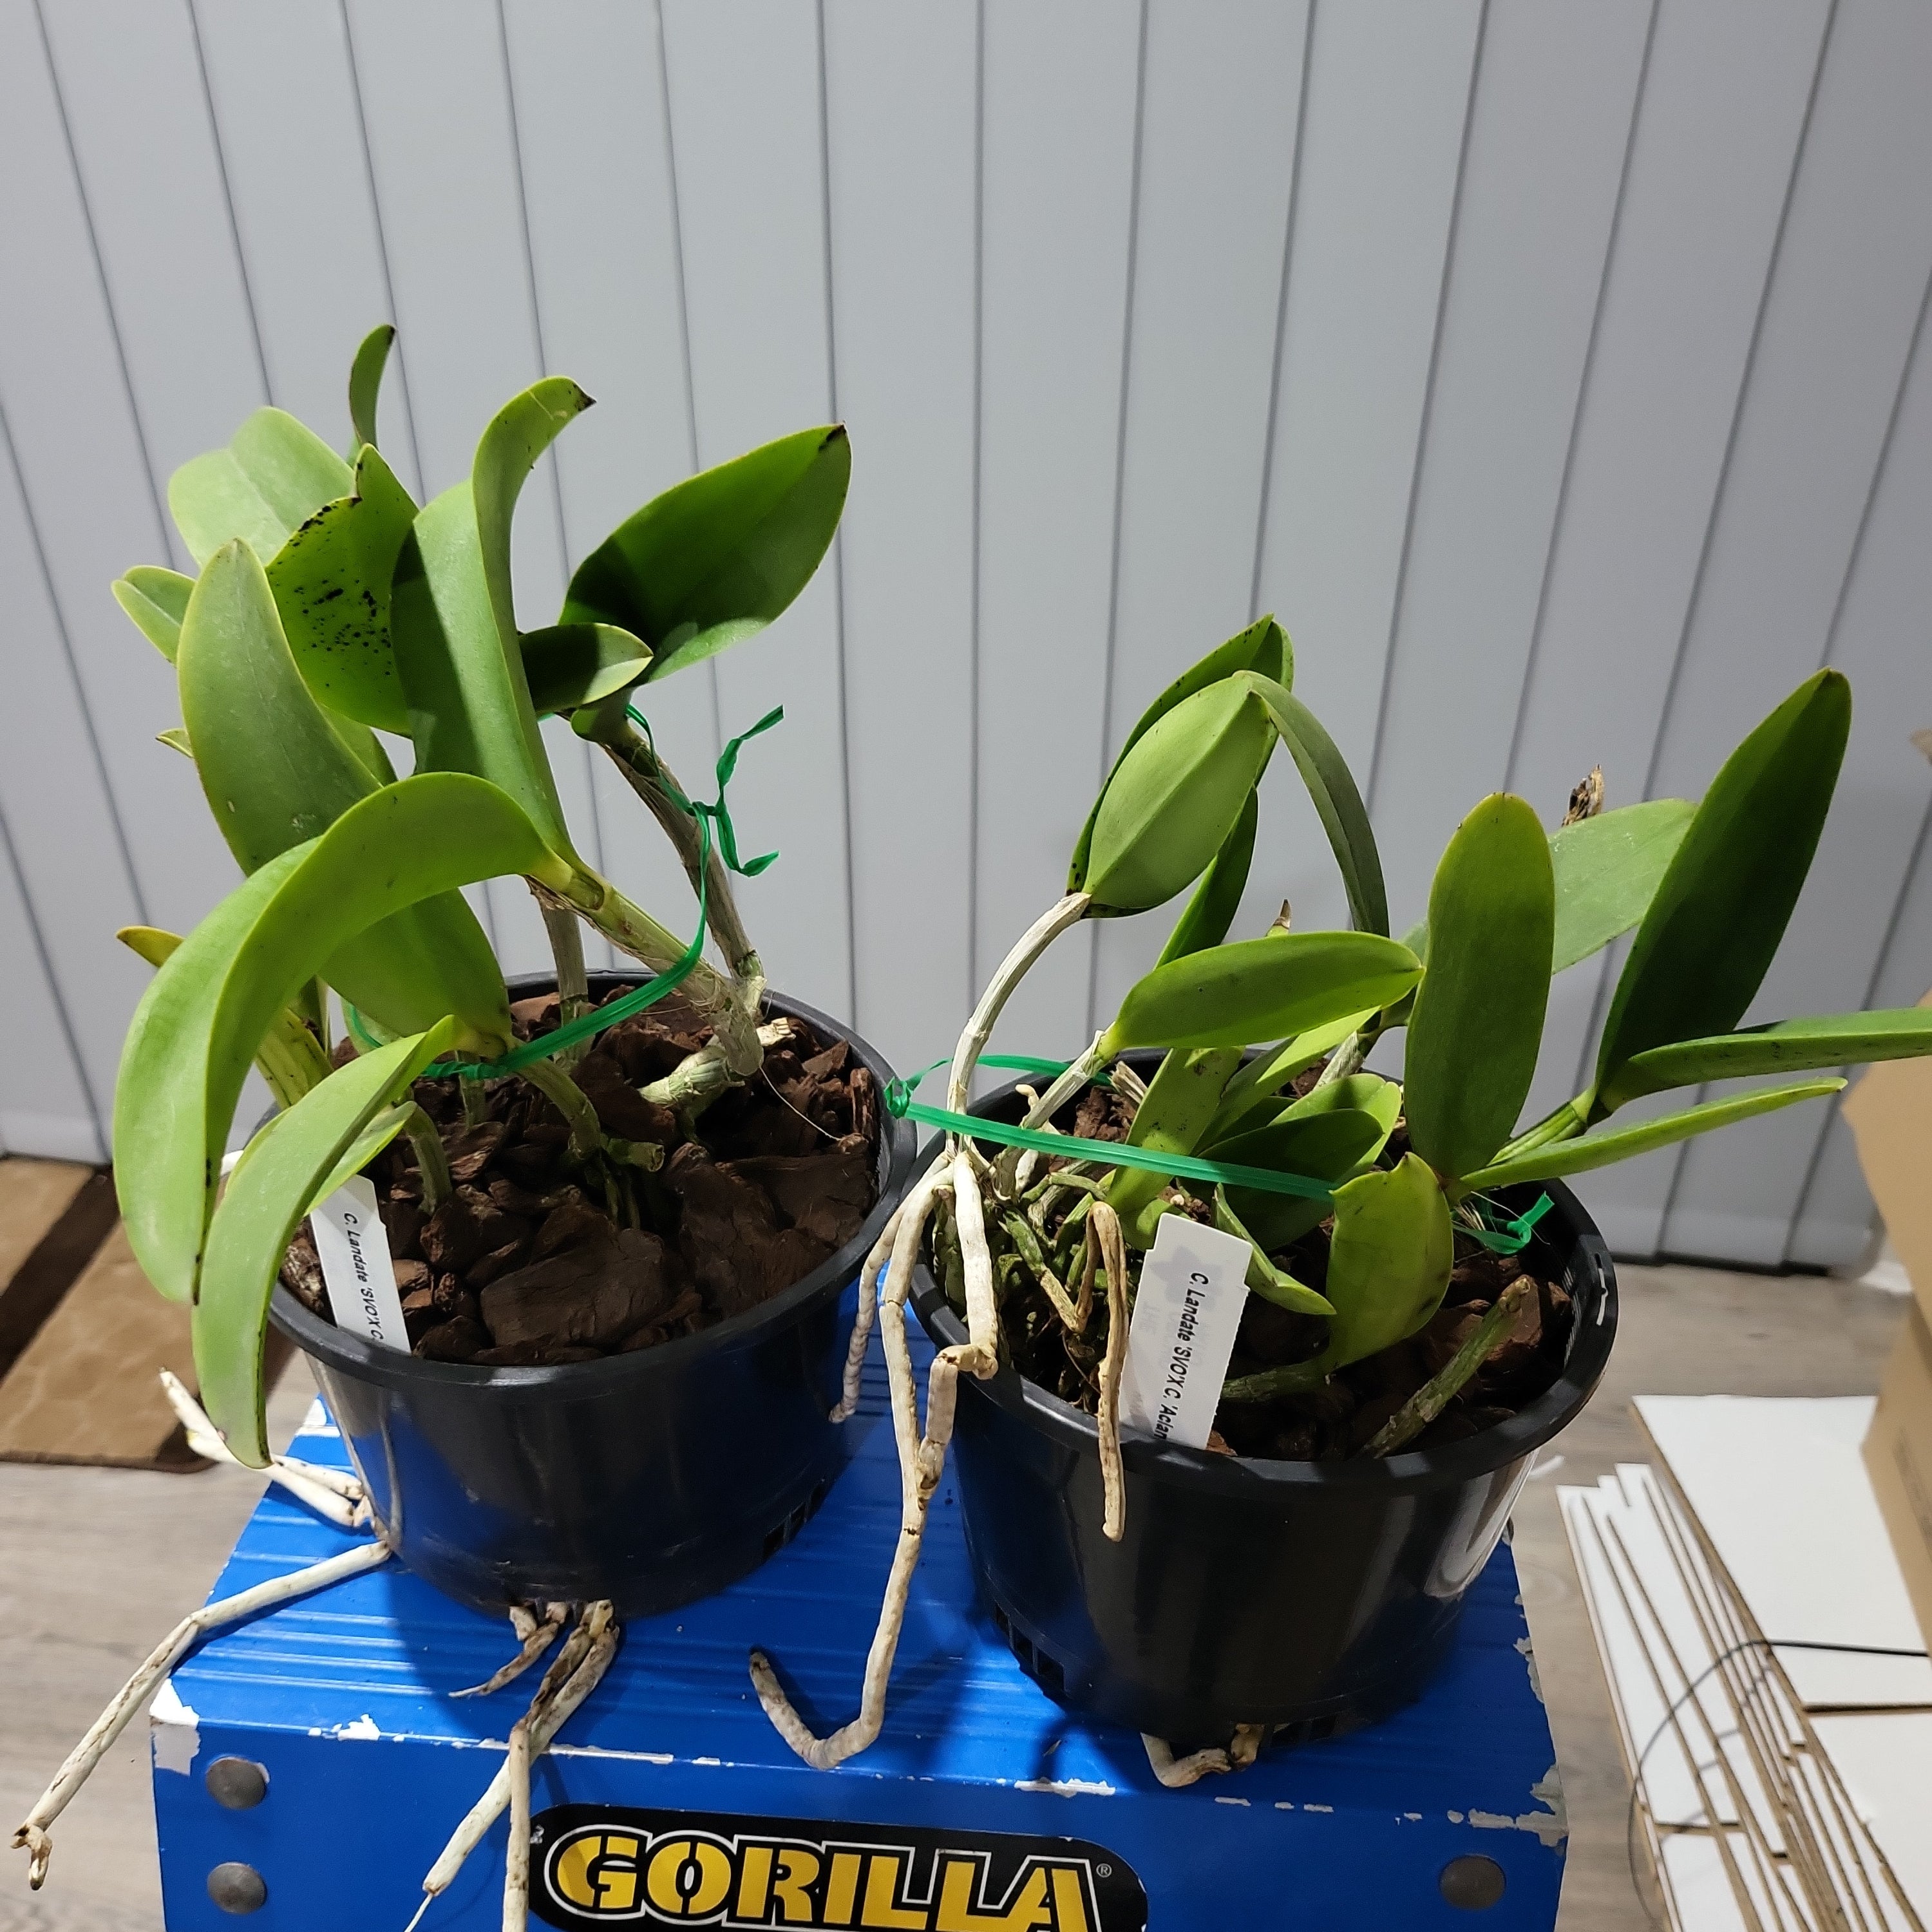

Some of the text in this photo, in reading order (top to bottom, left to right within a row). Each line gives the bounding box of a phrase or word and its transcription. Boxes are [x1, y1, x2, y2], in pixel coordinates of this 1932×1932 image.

[344, 1213, 358, 1225] C.
[347, 1230, 369, 1282] Landate
[1189, 1273, 1209, 1285] C.
[1177, 1288, 1206, 1342] Landate
[1163, 1387, 1181, 1399] C.
[547, 1826, 1097, 1932] GORILLA
